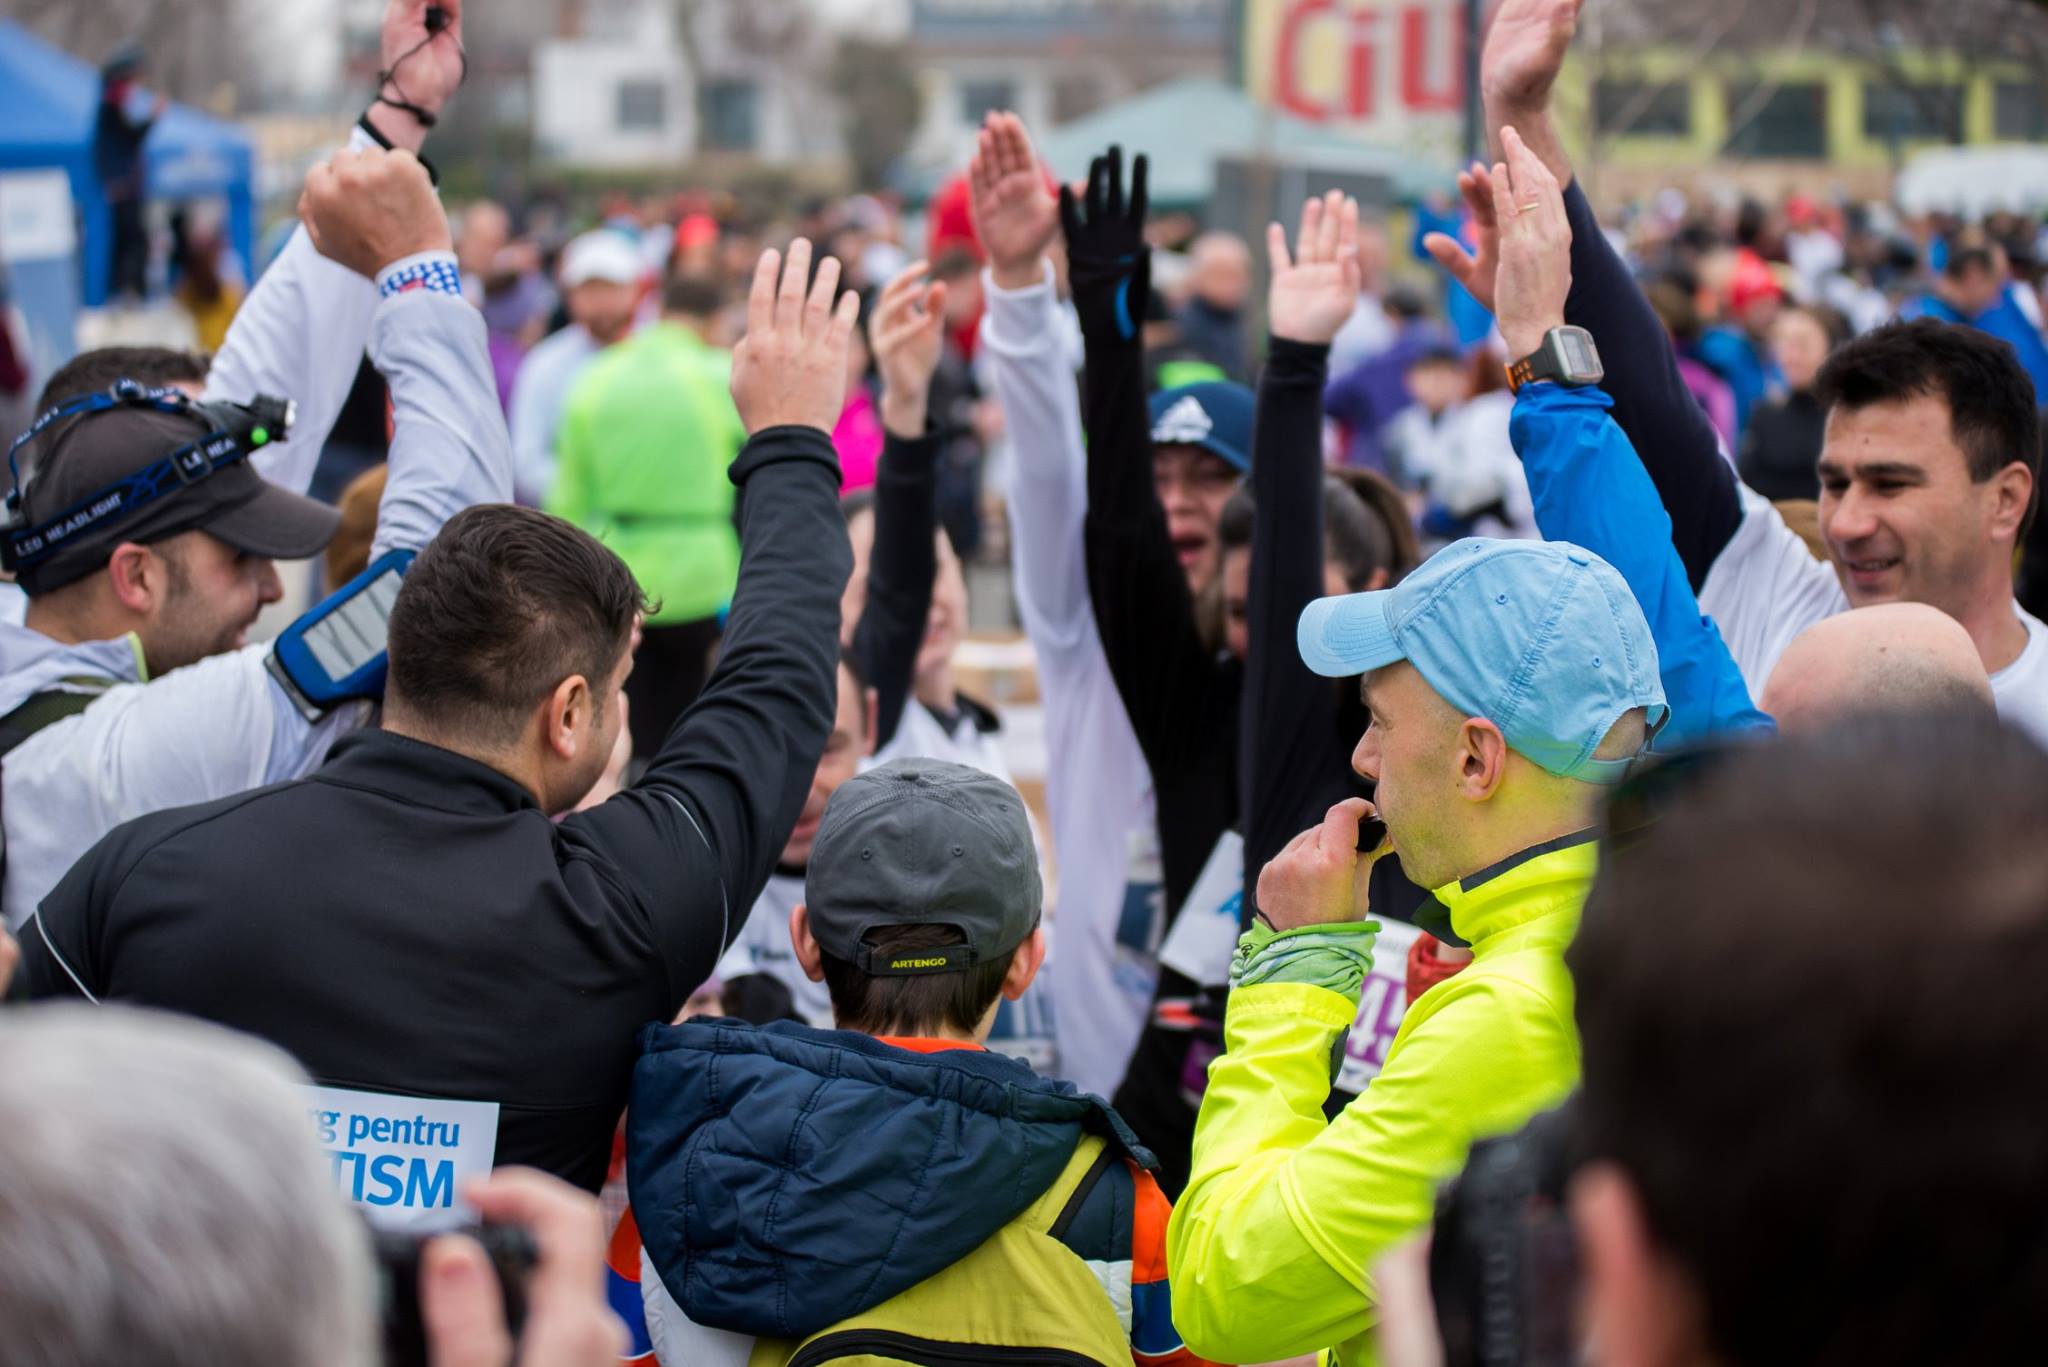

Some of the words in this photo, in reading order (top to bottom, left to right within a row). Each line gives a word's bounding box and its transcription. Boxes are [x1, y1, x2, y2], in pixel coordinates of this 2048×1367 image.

[16, 536, 43, 557] LED
[46, 492, 121, 543] HEADLIGHT
[892, 957, 946, 968] ARTENGO
[348, 1114, 460, 1148] pentru
